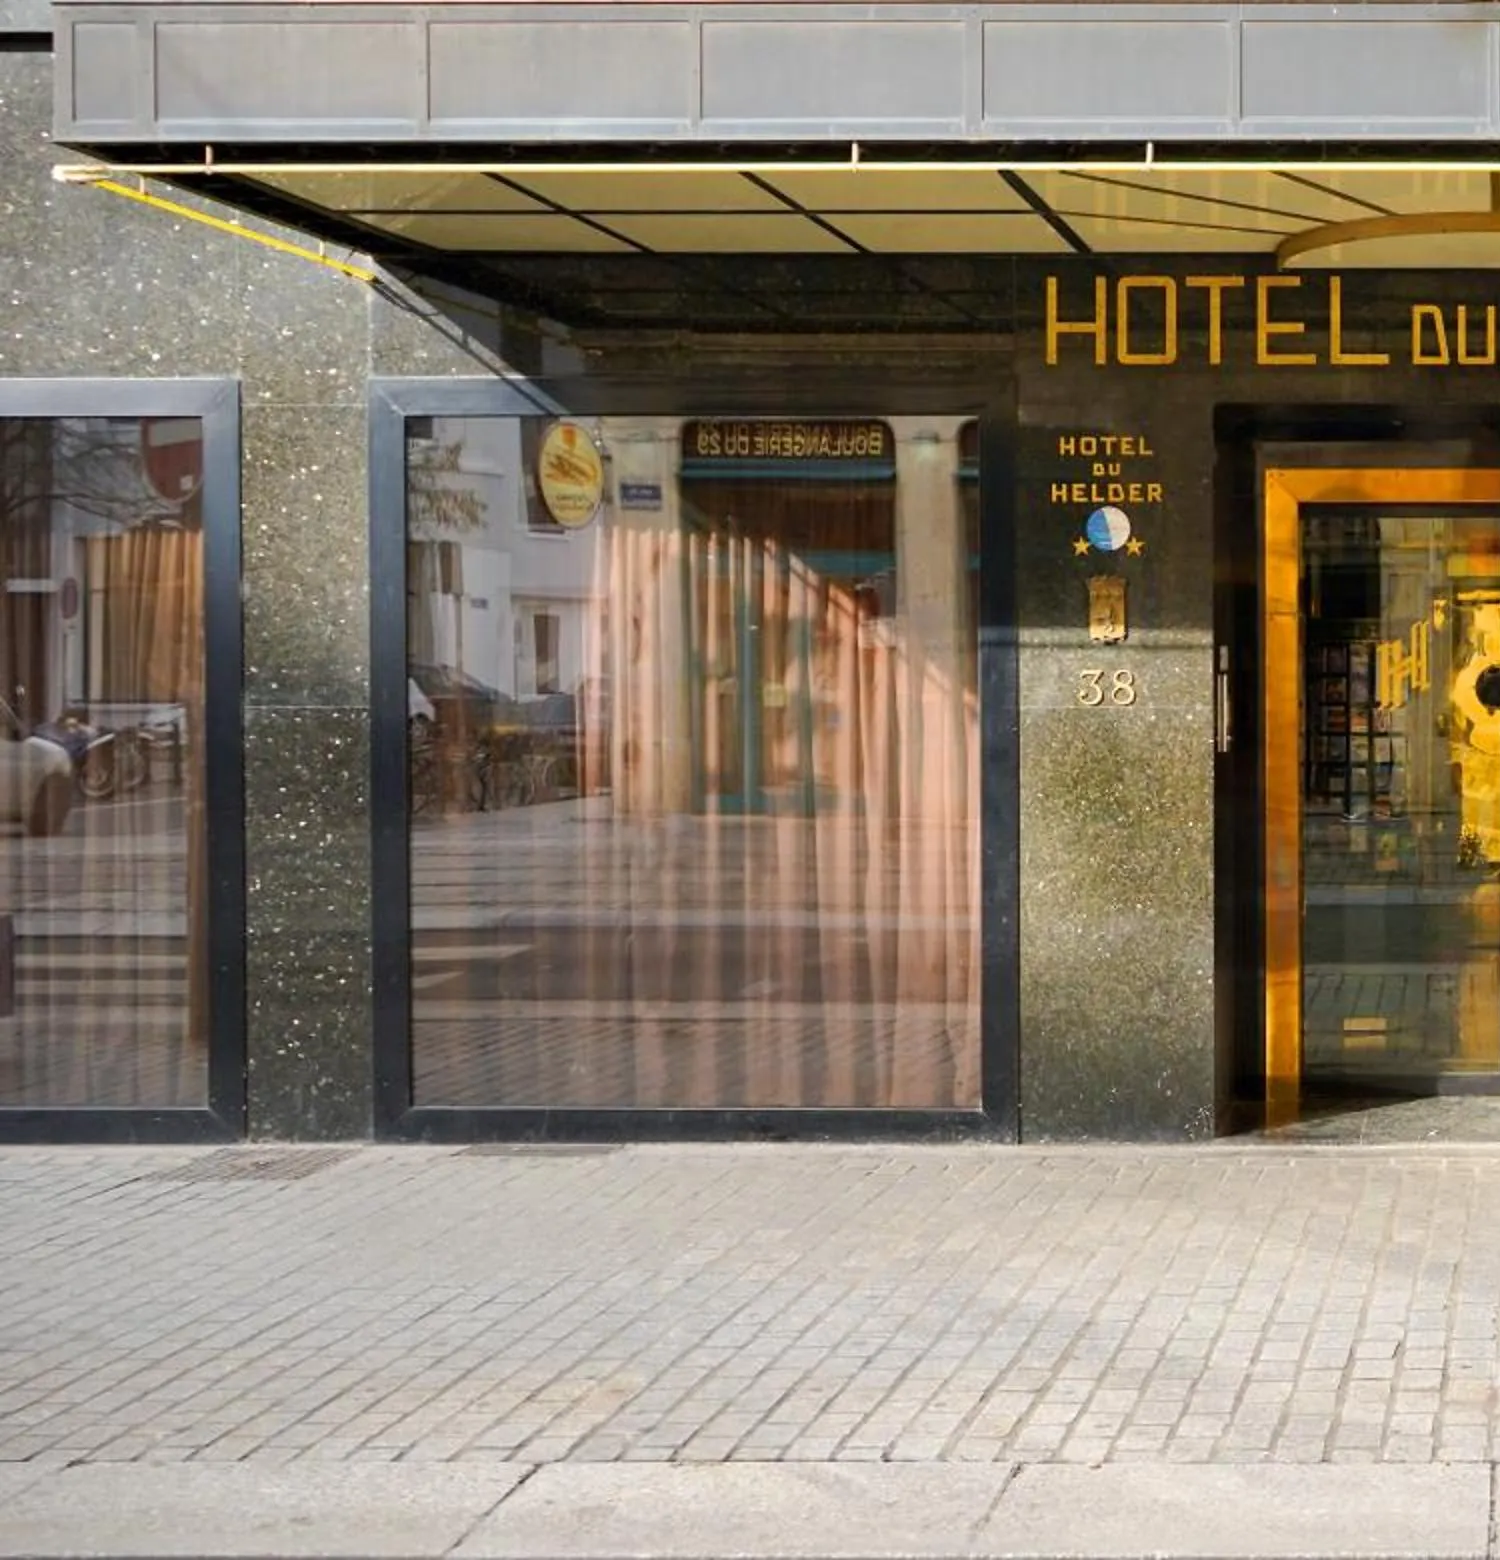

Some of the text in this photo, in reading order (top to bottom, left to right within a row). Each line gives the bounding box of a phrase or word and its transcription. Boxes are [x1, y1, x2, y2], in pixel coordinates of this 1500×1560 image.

[1047, 275, 1390, 366] HOTEL
[1412, 304, 1496, 366] DU
[1059, 435, 1154, 456] HOTEL
[1092, 462, 1122, 477] DU
[1051, 482, 1163, 503] HELDER
[1079, 668, 1136, 706] 38
